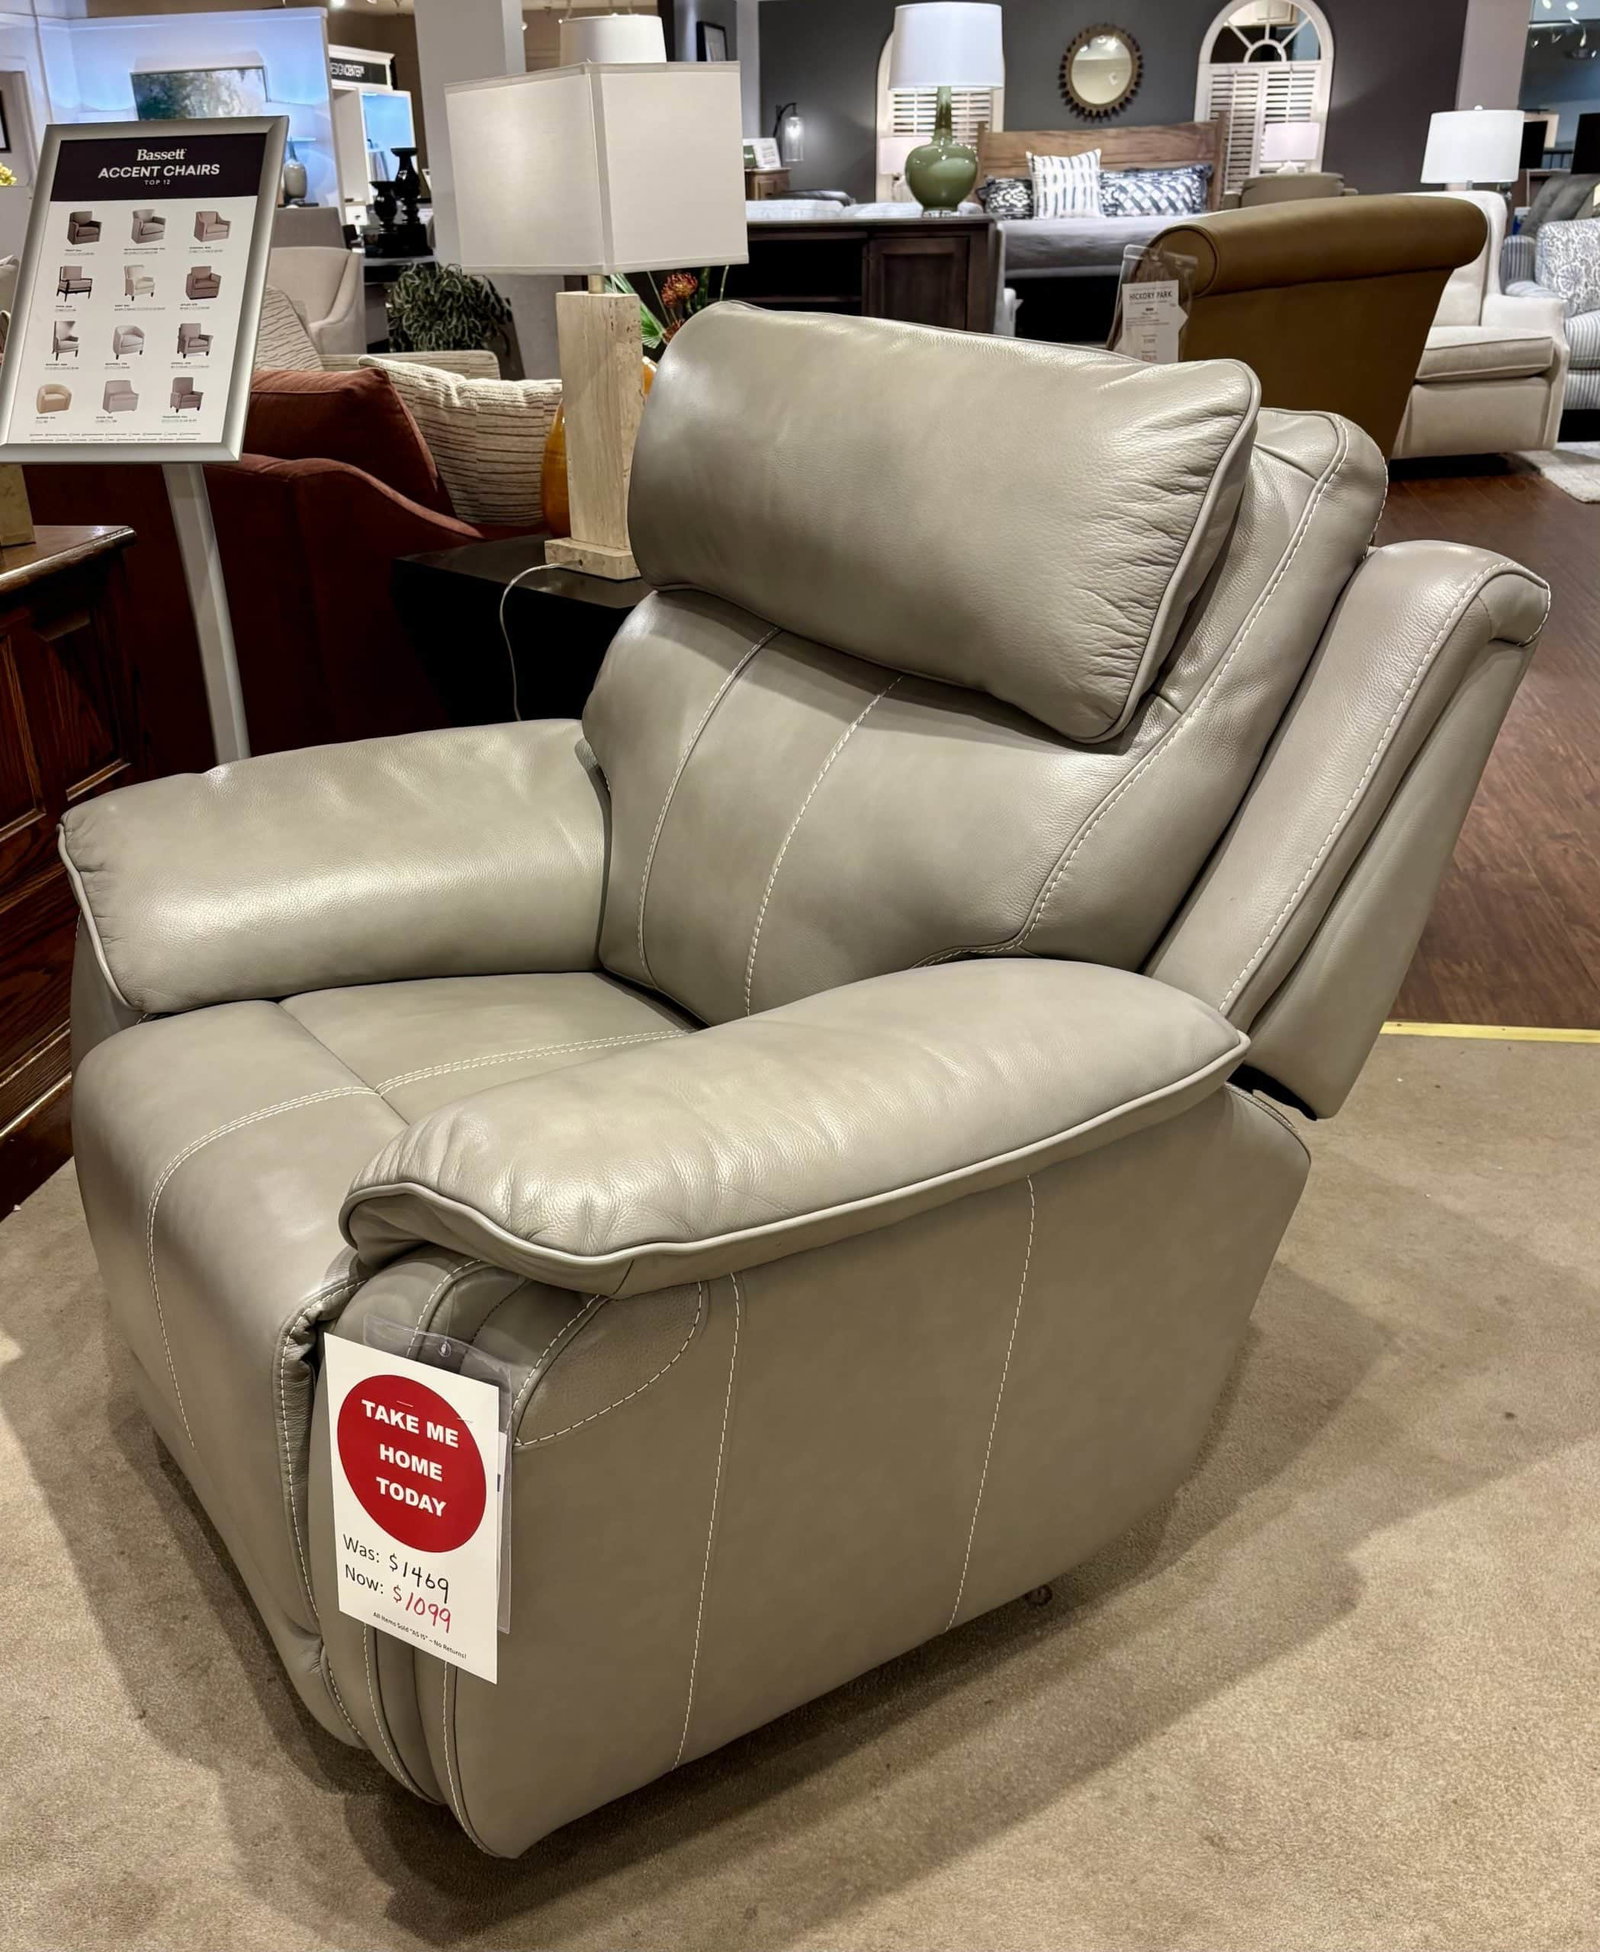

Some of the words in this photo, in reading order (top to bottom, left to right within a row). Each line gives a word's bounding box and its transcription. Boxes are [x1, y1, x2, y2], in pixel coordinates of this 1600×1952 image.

[98, 166, 160, 179] ACCENT
[163, 164, 220, 176] CHAIRS
[137, 148, 185, 161] Bassett
[1156, 290, 1173, 298] PARK
[361, 1399, 420, 1434] TAKE
[426, 1421, 459, 1449] ME
[380, 1443, 443, 1482] HOME
[375, 1476, 447, 1517] TODAY
[343, 1533, 380, 1564] Was:
[389, 1553, 449, 1605] $1469
[345, 1564, 384, 1595] Now:
[393, 1585, 451, 1633] $1099
[434, 1640, 442, 1648] No
[443, 1644, 467, 1659] Returns!
